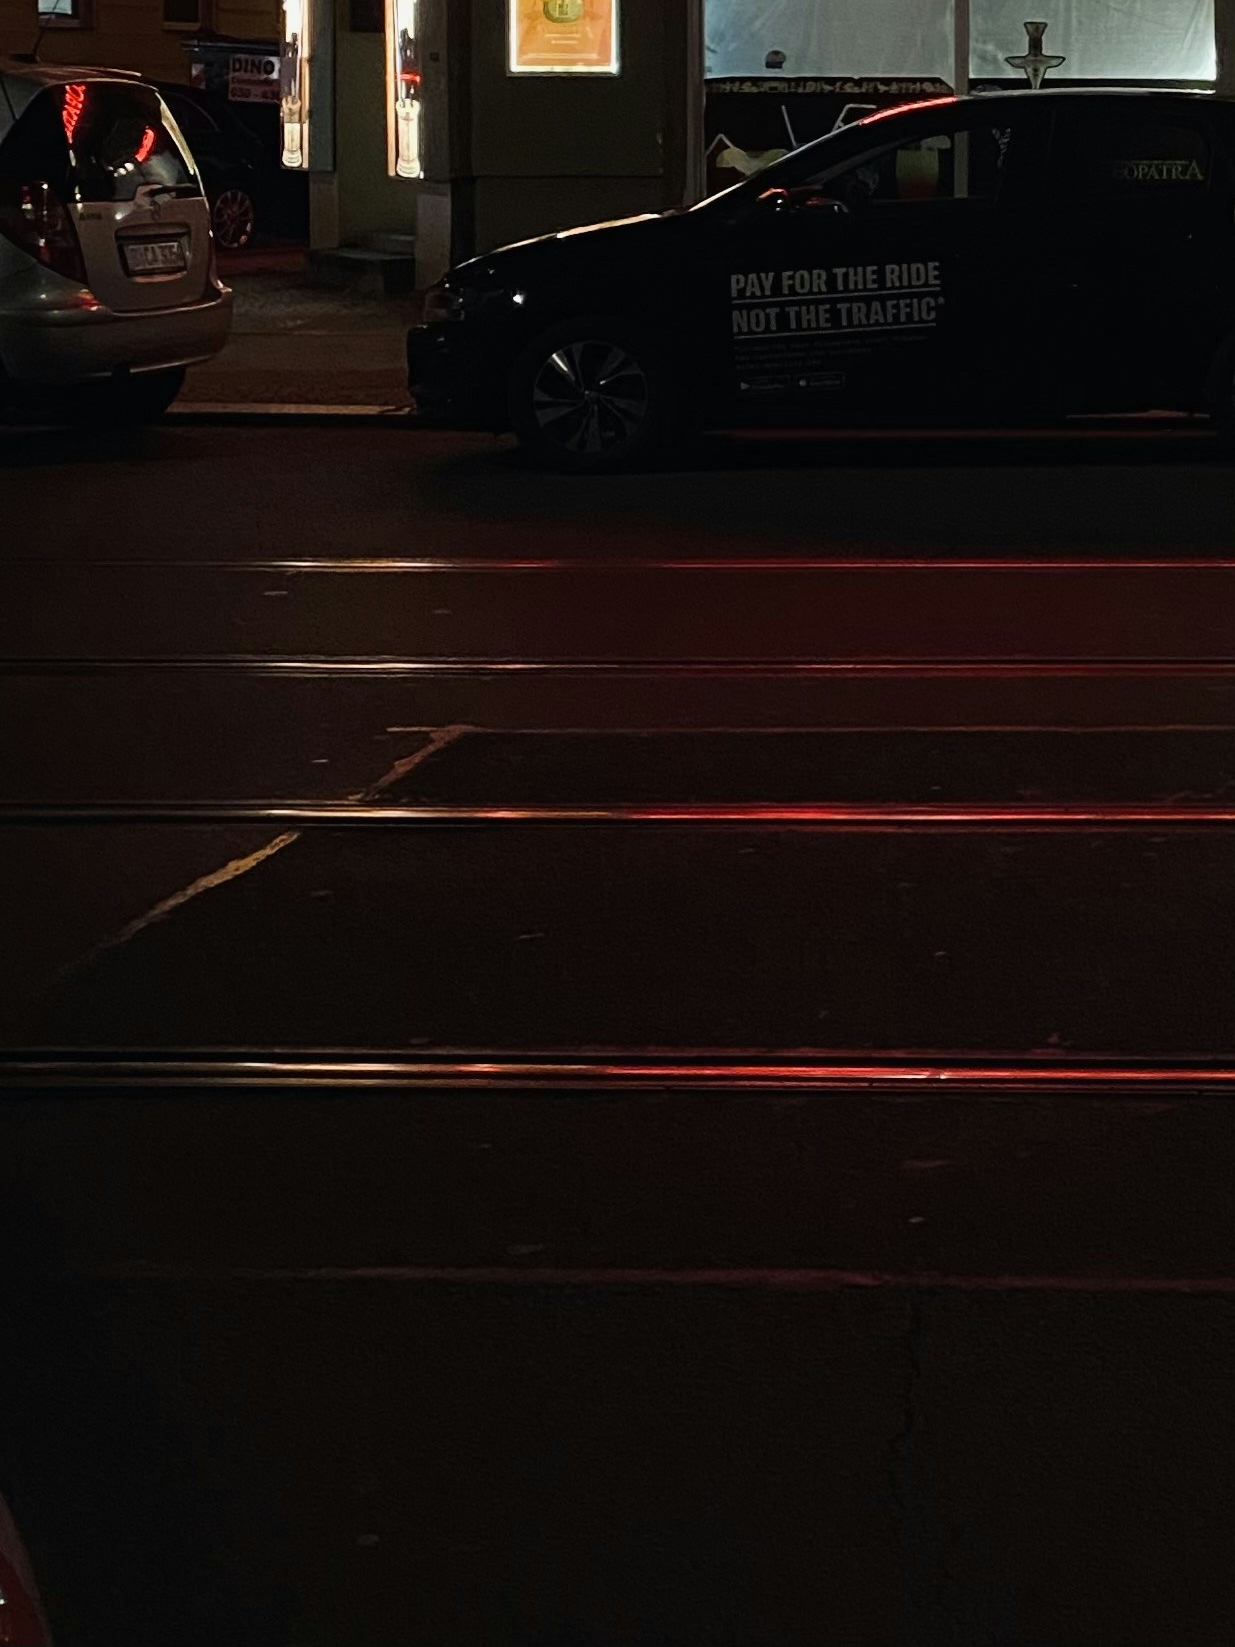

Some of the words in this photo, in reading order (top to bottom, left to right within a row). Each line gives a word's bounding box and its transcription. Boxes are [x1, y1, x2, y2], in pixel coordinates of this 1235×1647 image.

[232, 57, 275, 75] DINO
[730, 271, 775, 298] PAY
[781, 269, 828, 294] FOR
[832, 265, 879, 291] THE
[885, 261, 941, 288] RIDE
[731, 307, 780, 334] NOT
[785, 304, 832, 330] THE
